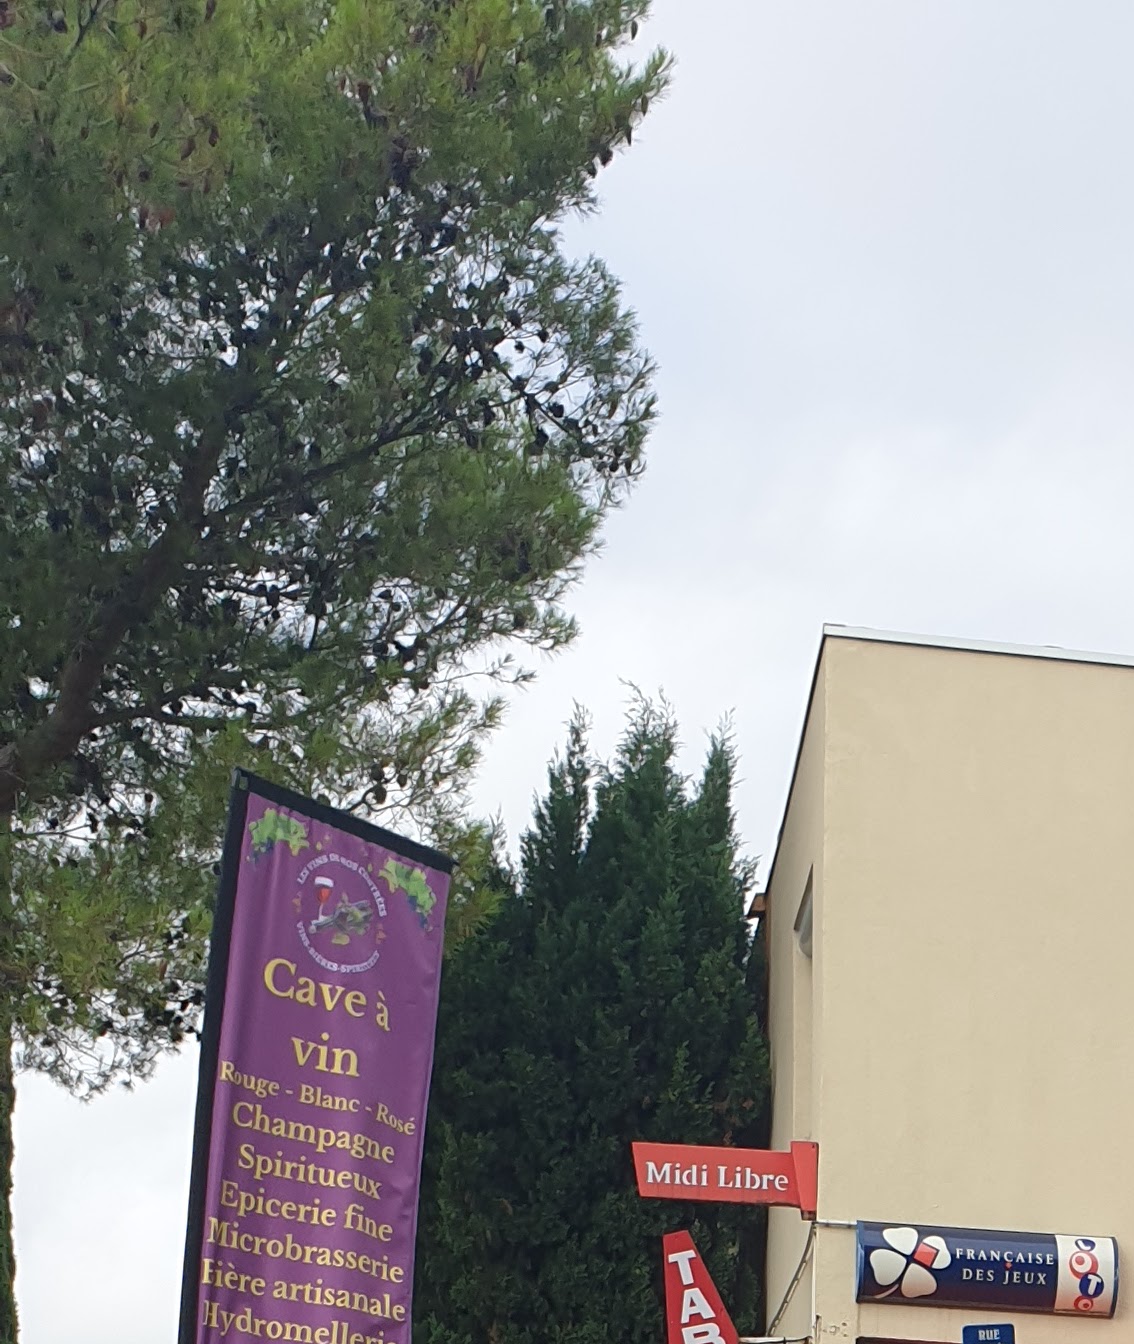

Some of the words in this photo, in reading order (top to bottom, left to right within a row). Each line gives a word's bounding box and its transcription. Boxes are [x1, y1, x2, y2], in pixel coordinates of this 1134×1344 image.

[263, 958, 368, 1018] Cave
[375, 990, 391, 1032] à
[291, 1032, 361, 1078] vin
[219, 1061, 280, 1098] Rouge
[300, 1084, 361, 1113] Blanc
[375, 1101, 416, 1135] Rosé
[233, 1102, 396, 1164] Champagne
[238, 1143, 383, 1200] Spiritueux
[645, 1161, 709, 1187] Midi
[717, 1165, 790, 1192] Libre
[220, 1180, 337, 1227] Epicerie
[343, 1203, 394, 1243] fine
[206, 1216, 405, 1283] Microbrasserie
[955, 1248, 1055, 1266] FRANÇAISE
[272, 1278, 406, 1322] artisanale
[962, 1268, 995, 1281] DES
[1002, 1271, 1047, 1285] JEUX
[978, 1329, 1001, 1342] RUE
